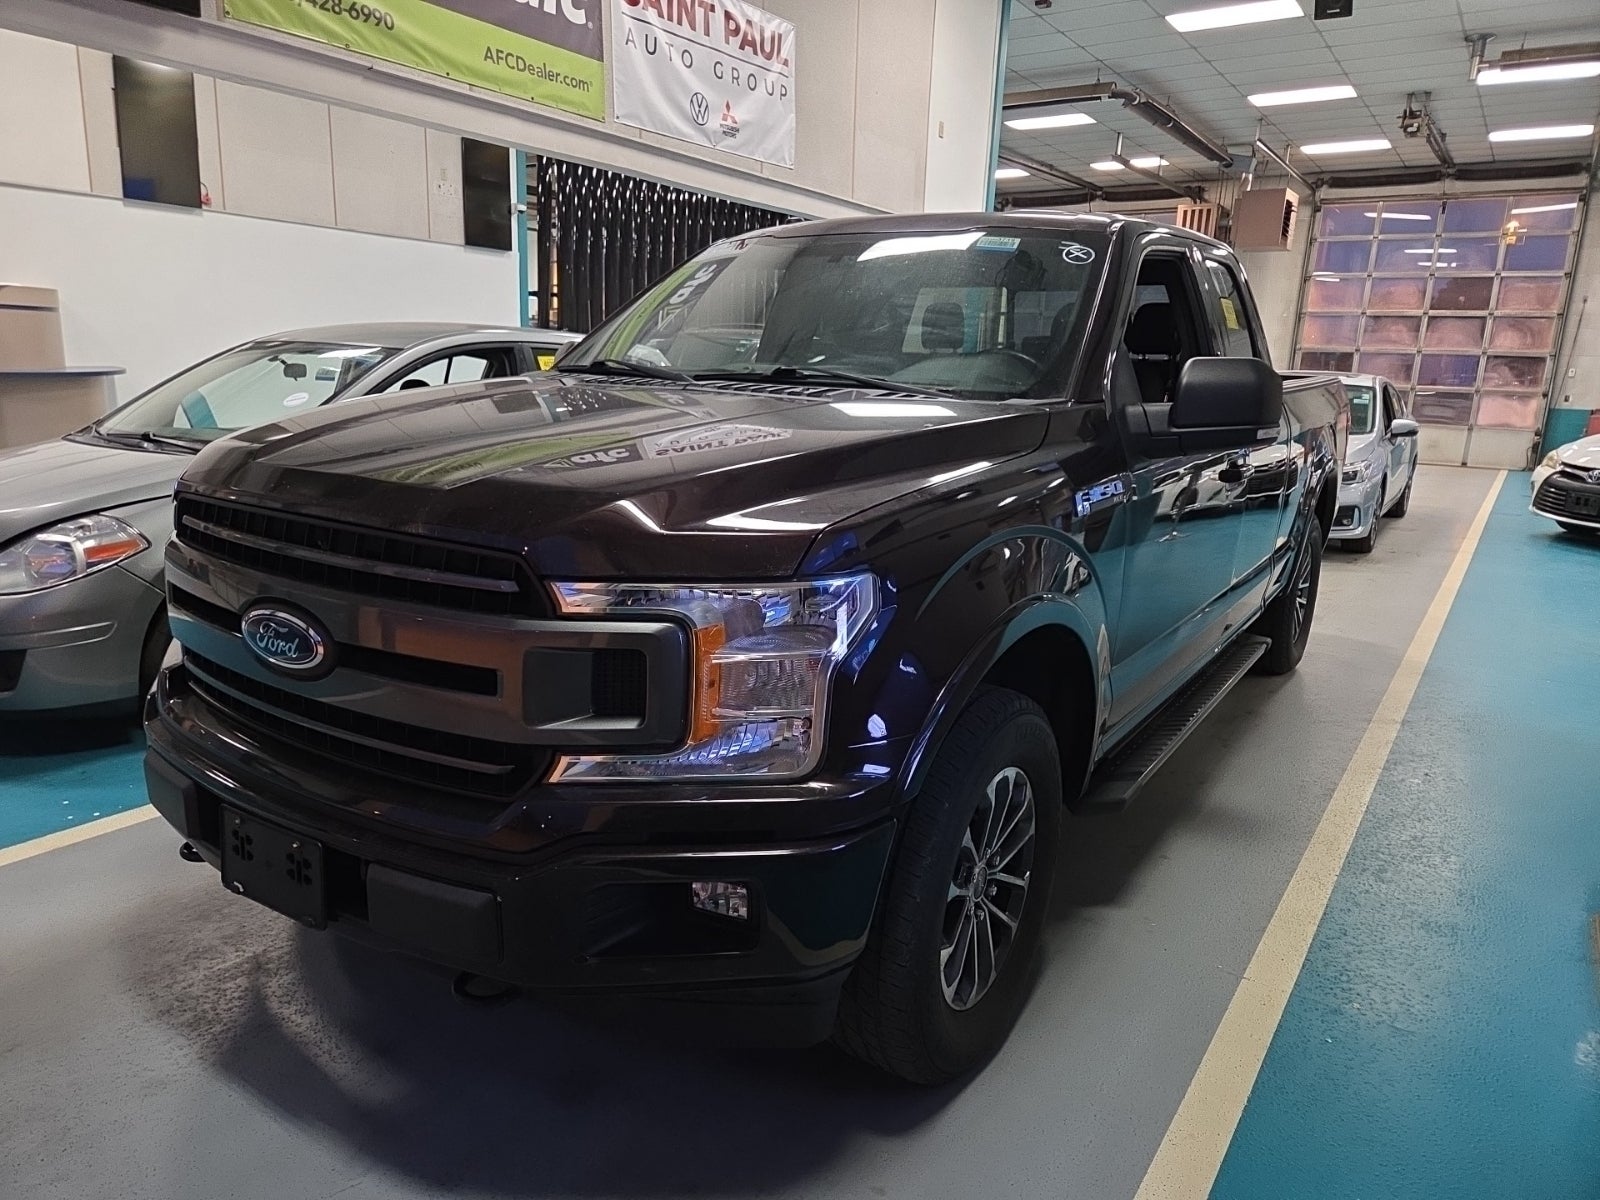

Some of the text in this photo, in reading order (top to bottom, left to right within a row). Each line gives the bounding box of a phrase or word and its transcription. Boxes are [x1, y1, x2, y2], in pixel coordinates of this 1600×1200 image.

[623, 0, 716, 37] AINT
[724, 9, 789, 68] PAUL
[483, 46, 590, 92] AFCDealer.com
[625, 27, 788, 101] AUTO GROUP
[257, 621, 299, 658] Ford
